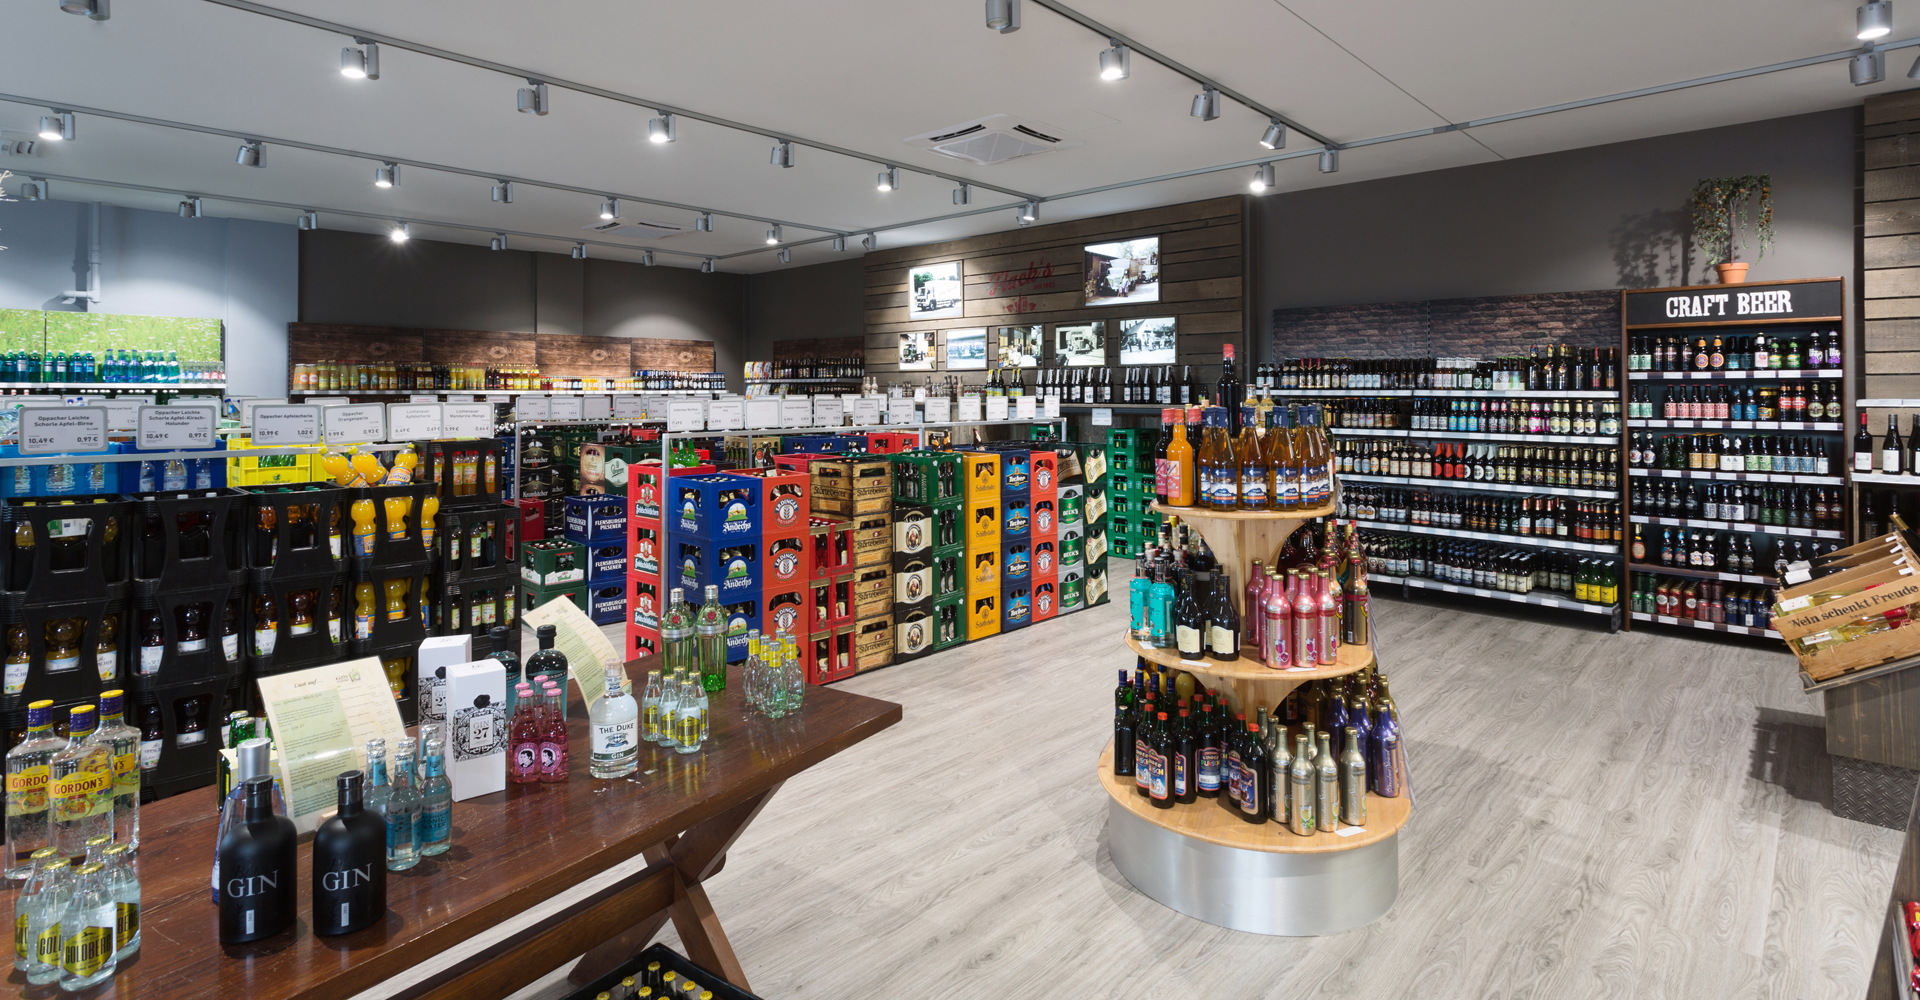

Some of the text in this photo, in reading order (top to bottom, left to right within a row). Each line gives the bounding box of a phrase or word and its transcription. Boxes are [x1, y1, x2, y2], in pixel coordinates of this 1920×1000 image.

[1666, 290, 1793, 318] CRAFT BEER
[775, 498, 798, 512] ERDINGER
[595, 518, 627, 526] FLENSBURGER
[723, 520, 752, 534] Andechs
[595, 558, 627, 567] FLENSBURGER
[774, 553, 798, 566] ERDINGER
[600, 564, 622, 572] PILSENER
[724, 578, 752, 590] Andechs
[595, 599, 627, 608] FLENSBURGER
[600, 605, 622, 613] PILSENER
[1821, 599, 1871, 621] schenkt
[1870, 585, 1919, 605] Freude
[774, 608, 797, 622] ERDINGER
[505, 673, 520, 681] ONDON
[434, 690, 446, 698] GI
[472, 720, 490, 729] GIN
[599, 722, 634, 735] THE DUKE
[473, 728, 489, 739] 27
[12, 774, 48, 788] GORDO
[54, 777, 103, 794] GORDON'S
[422, 802, 449, 811] EVER-TREE
[423, 817, 445, 825] TONIC
[423, 822, 446, 831] WATER
[322, 862, 373, 891] GIN
[227, 869, 279, 898] GIN
[118, 910, 138, 934] BERG
[65, 934, 111, 964] GOLDBERG
